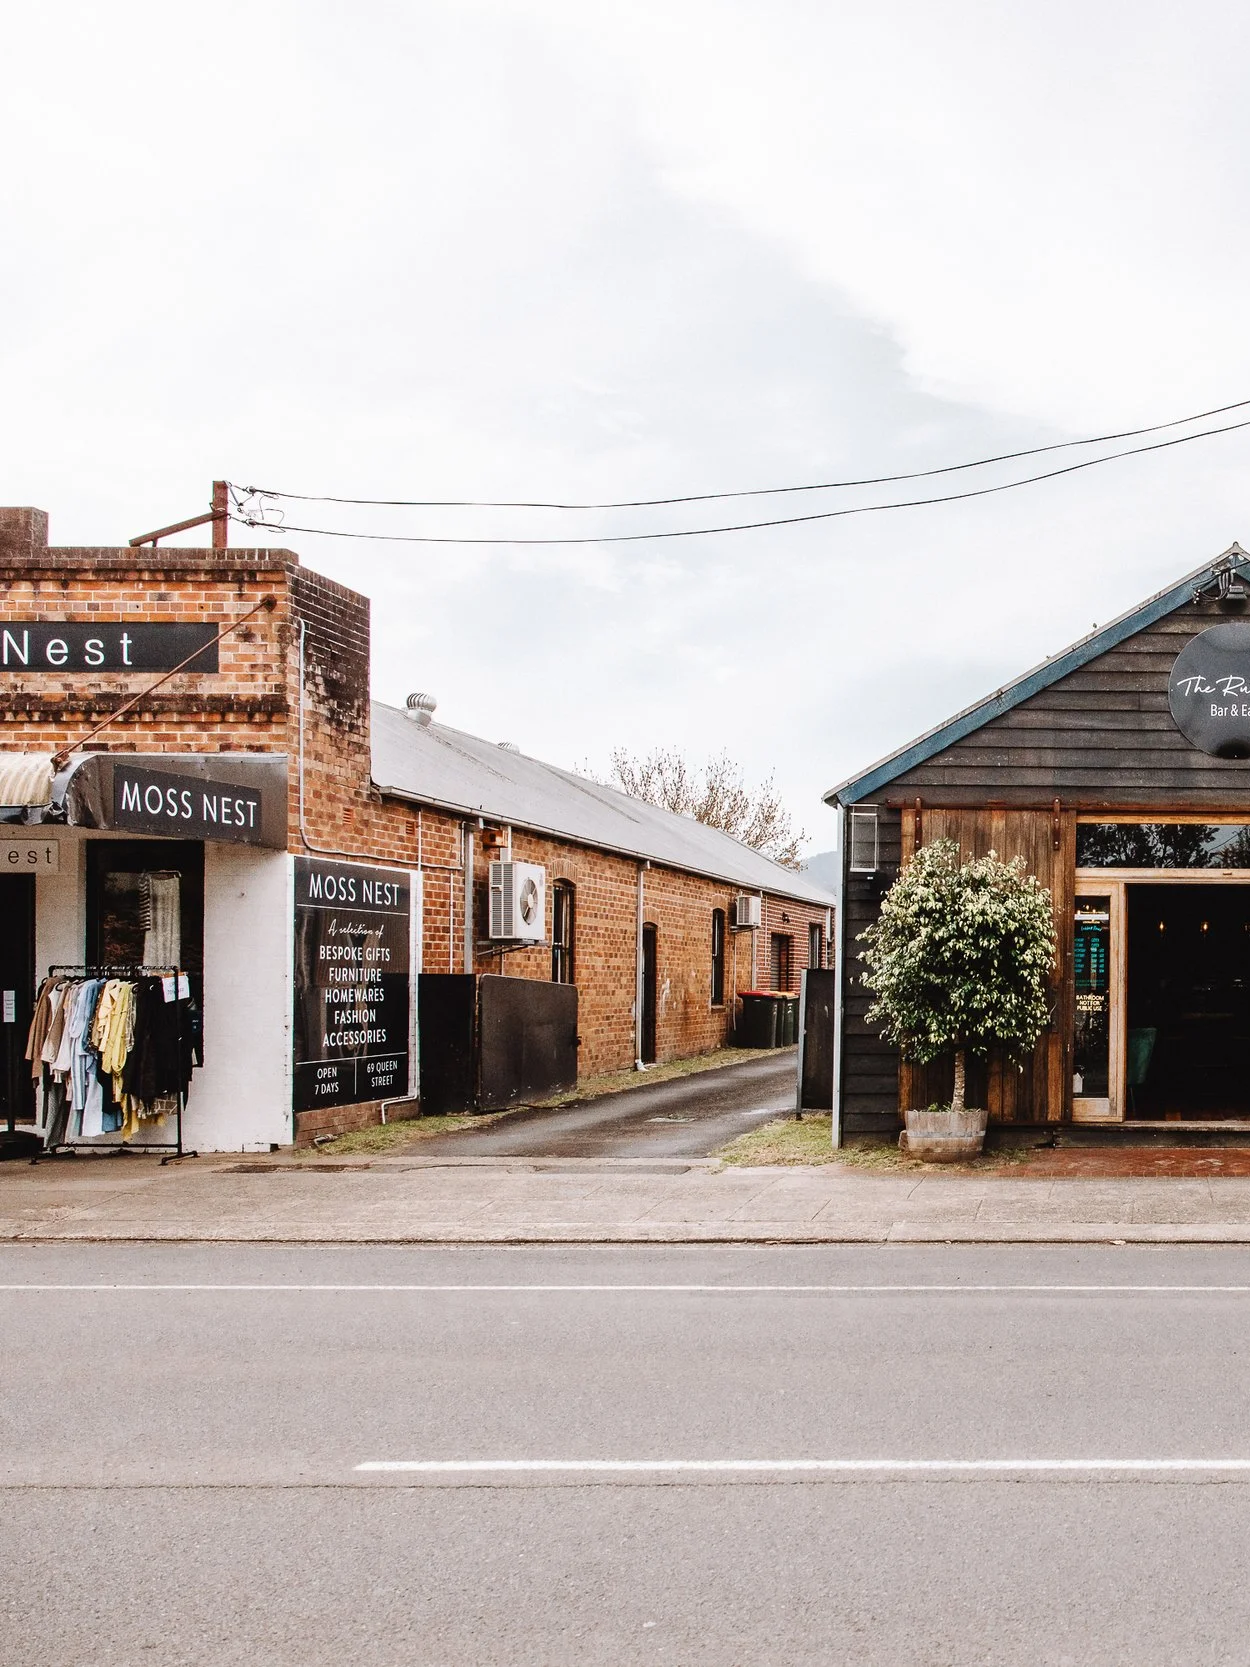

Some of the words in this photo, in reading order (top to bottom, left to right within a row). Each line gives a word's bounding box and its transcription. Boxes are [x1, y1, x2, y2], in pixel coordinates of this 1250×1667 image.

[2, 629, 133, 665] Nest
[1177, 674, 1216, 697] The
[1210, 704, 1229, 717] Bar
[1230, 703, 1239, 717] &
[121, 780, 193, 819] MOSS
[203, 793, 257, 828] NEST
[309, 873, 356, 902] MOSS
[362, 880, 400, 906] NEST
[328, 918, 337, 937] A
[339, 922, 374, 935] selection
[375, 924, 384, 939] of
[319, 945, 363, 961] BESPOKE
[365, 947, 391, 962] GIFTS
[329, 967, 382, 982] FURNITURE
[325, 988, 385, 1004] HOMEWARES
[334, 1009, 376, 1025] FASHION
[322, 1029, 387, 1047] ACCESSORIES
[316, 1066, 338, 1079] OPEN
[366, 1062, 375, 1074] 69
[376, 1060, 398, 1074] QUEEN
[314, 1084, 320, 1095] 7
[320, 1082, 340, 1095] DAYS
[371, 1074, 394, 1088] STREET
